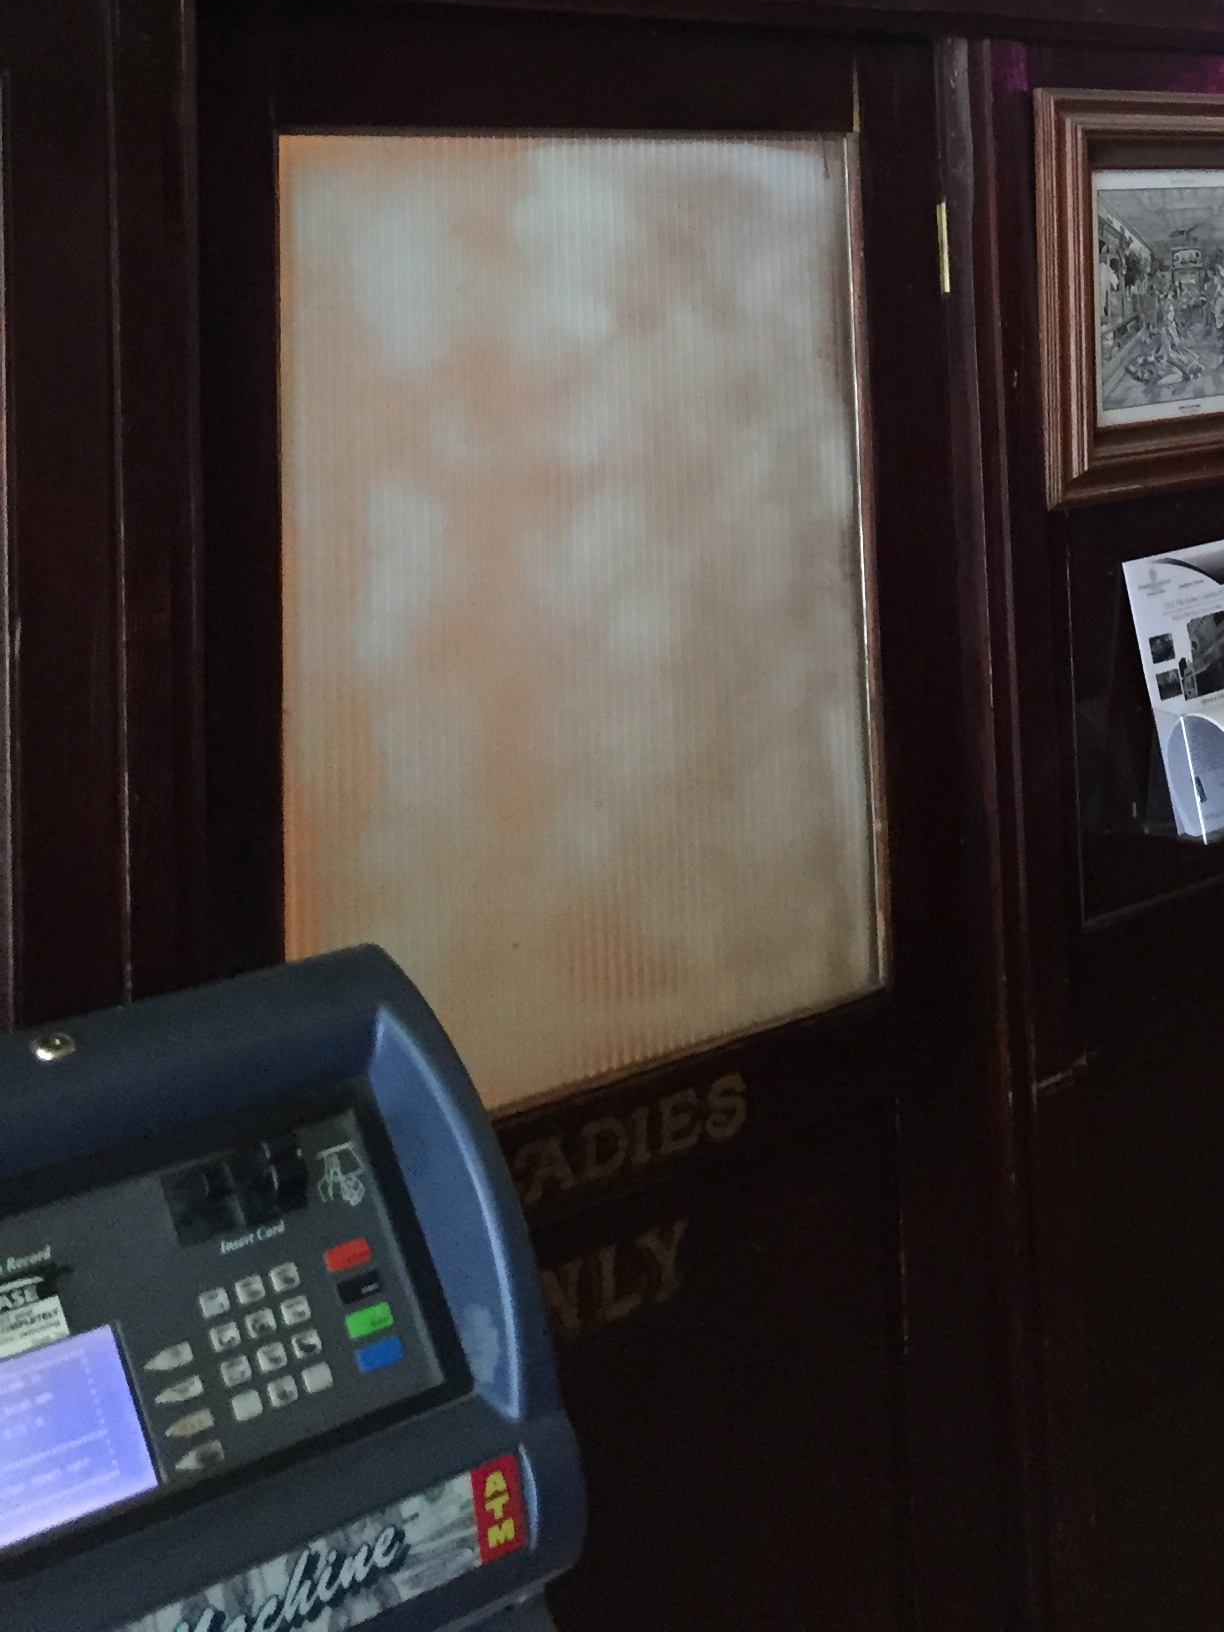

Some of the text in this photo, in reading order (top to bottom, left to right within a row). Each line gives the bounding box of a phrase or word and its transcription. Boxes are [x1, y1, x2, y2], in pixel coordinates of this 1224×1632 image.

[514, 1072, 747, 1204] ADIES
[541, 1218, 689, 1330] NLY
[484, 1470, 515, 1549] ATM
